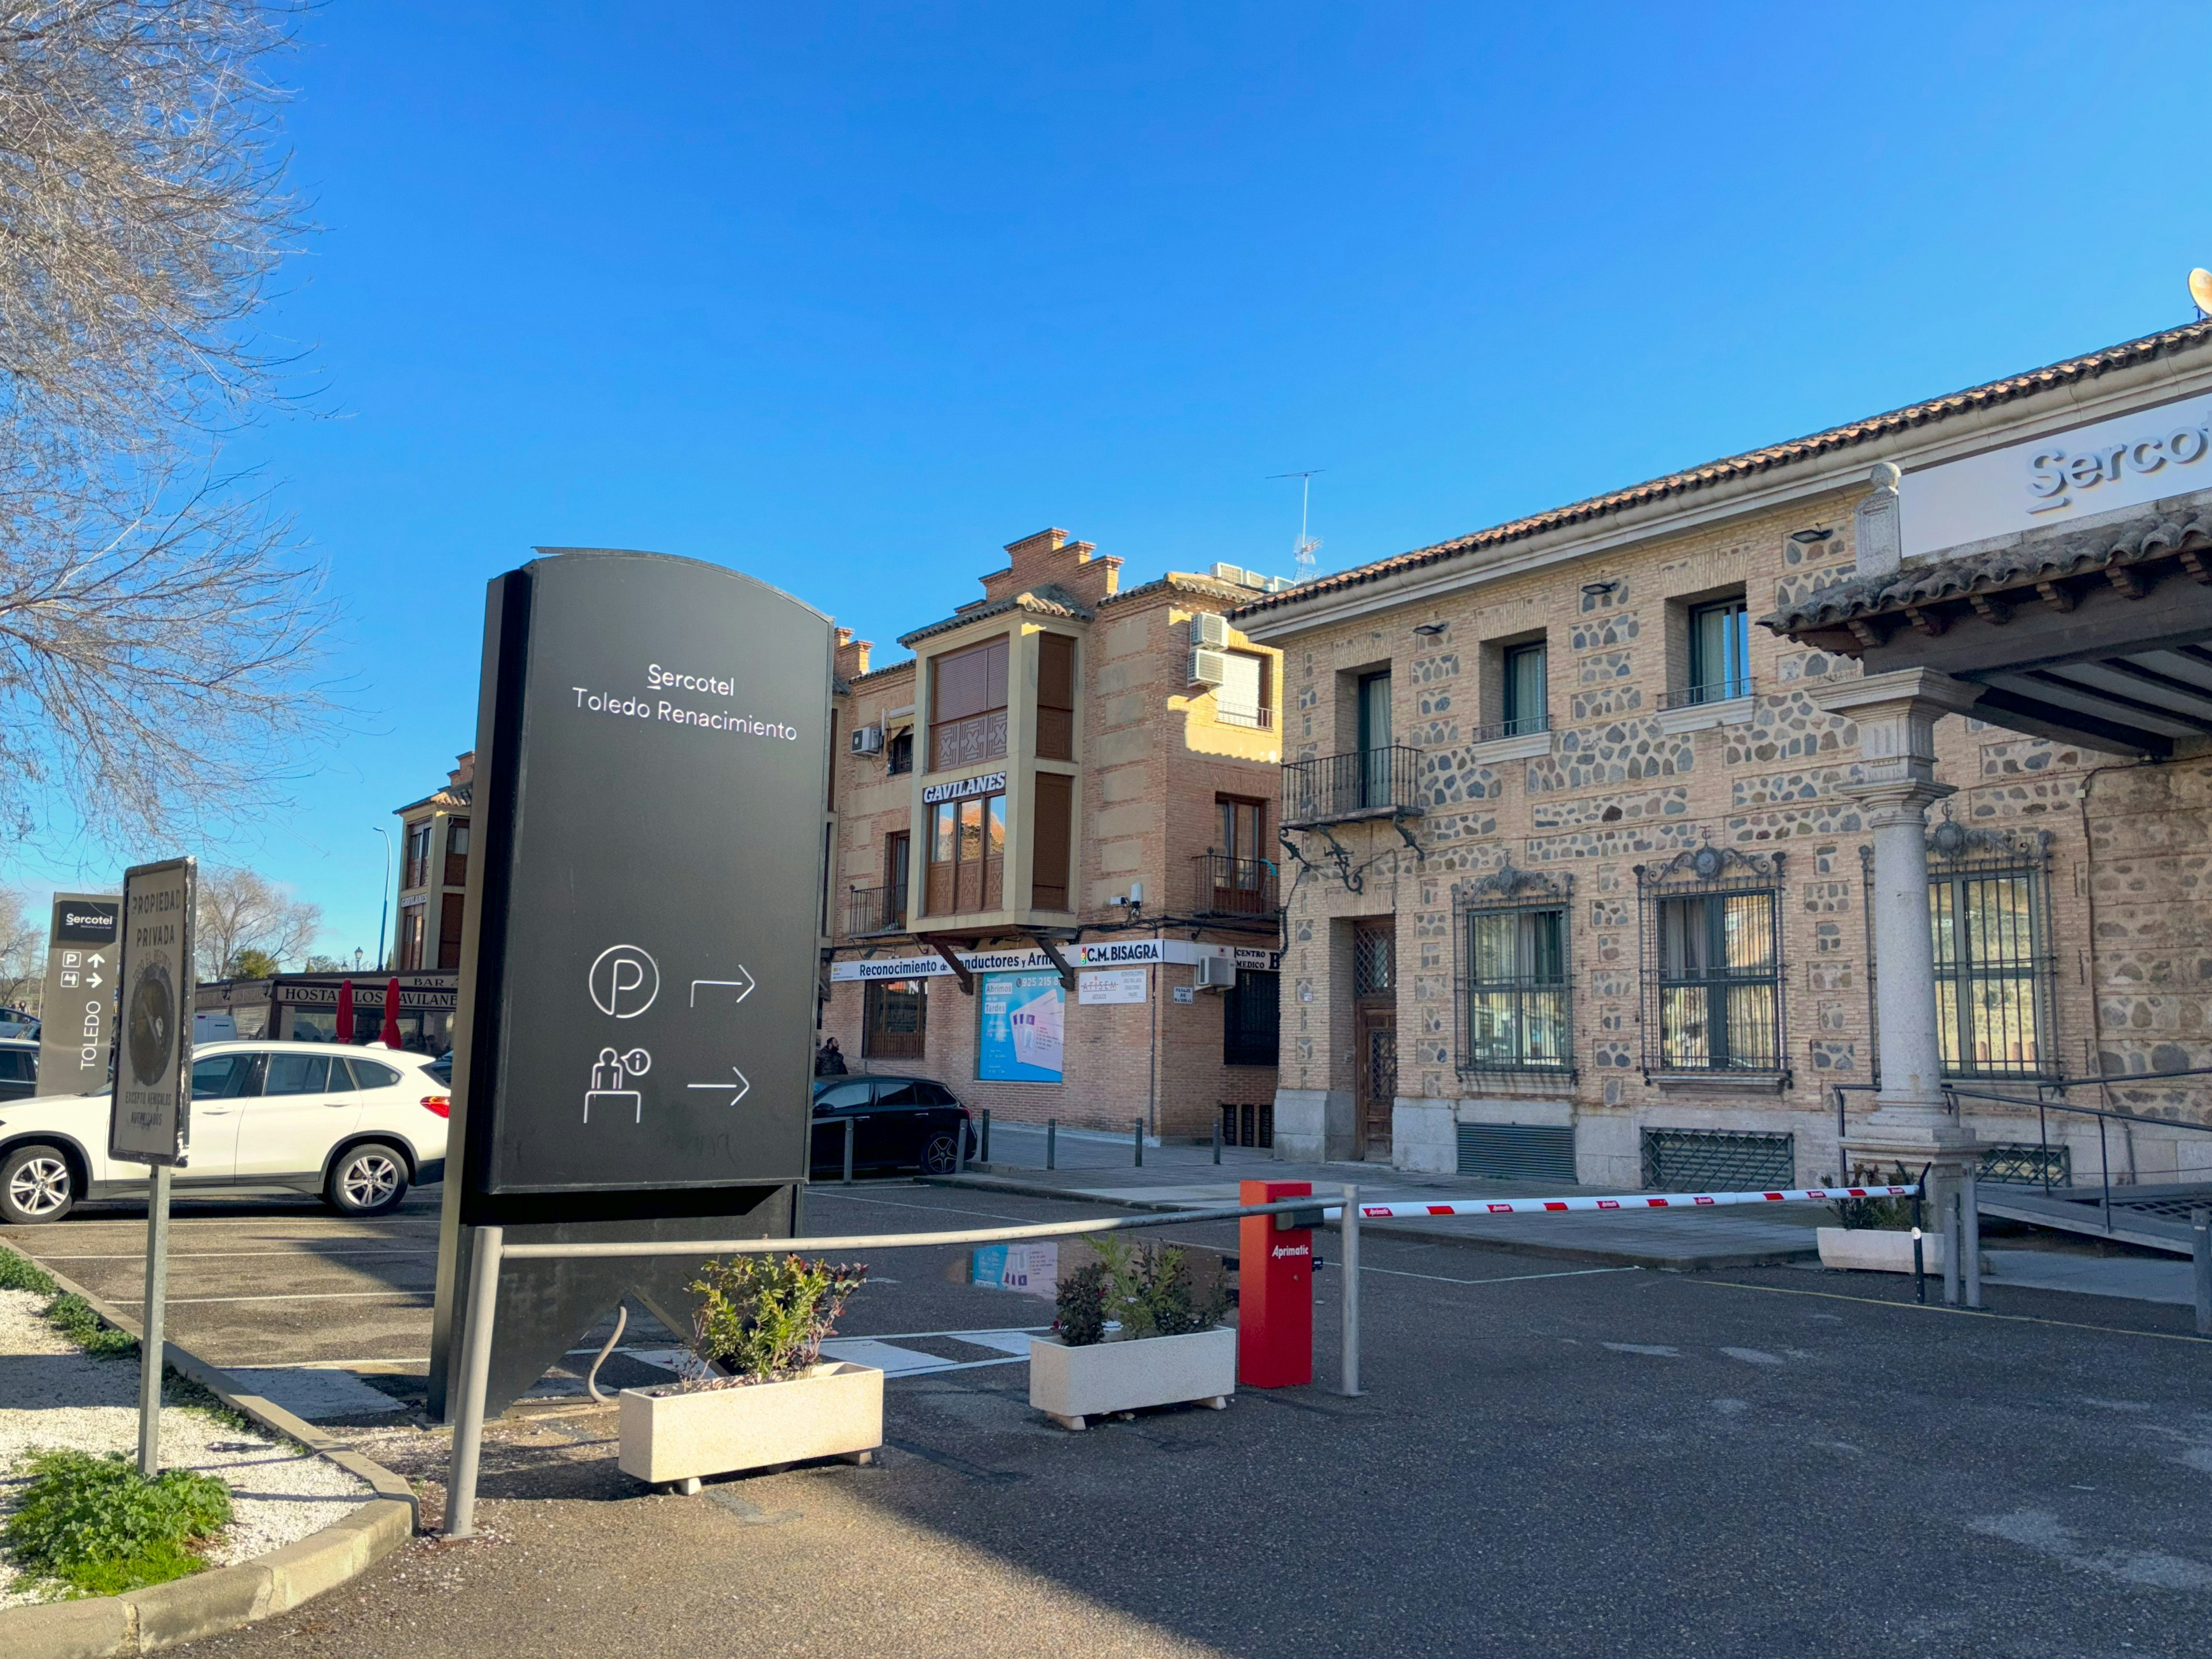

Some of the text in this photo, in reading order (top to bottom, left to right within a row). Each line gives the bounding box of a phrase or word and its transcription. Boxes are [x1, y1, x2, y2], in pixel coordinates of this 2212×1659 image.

[647, 664, 735, 696] Sercotel
[572, 687, 797, 741] Toledo Renacimiento
[924, 772, 1006, 803] GAVILANES
[132, 890, 181, 915] PROPIEDAD
[401, 894, 427, 907] GAVILANES
[65, 913, 113, 926] Sercotel
[137, 924, 175, 947] PRIVADA
[1087, 944, 1159, 963] C.M. BISAGRA
[1236, 949, 1265, 957] CENTRO
[860, 960, 937, 976] Reconocimiento
[940, 963, 947, 971] de
[959, 953, 1019, 969] onductores
[1022, 960, 1026, 968] y
[1236, 960, 1265, 968] MEDICO
[414, 978, 444, 987] BAR
[1022, 976, 1061, 987] 925 215 8
[1082, 982, 1117, 991] AFISEM
[986, 985, 1011, 993] Abrimos
[285, 988, 458, 1006] HOSTA LOS AVILANE
[986, 1004, 1006, 1012] Tardes
[80, 1001, 101, 1070] TOLEDO
[125, 1092, 146, 1104] EXCEPTO
[1271, 1244, 1309, 1259] Aprimatic
